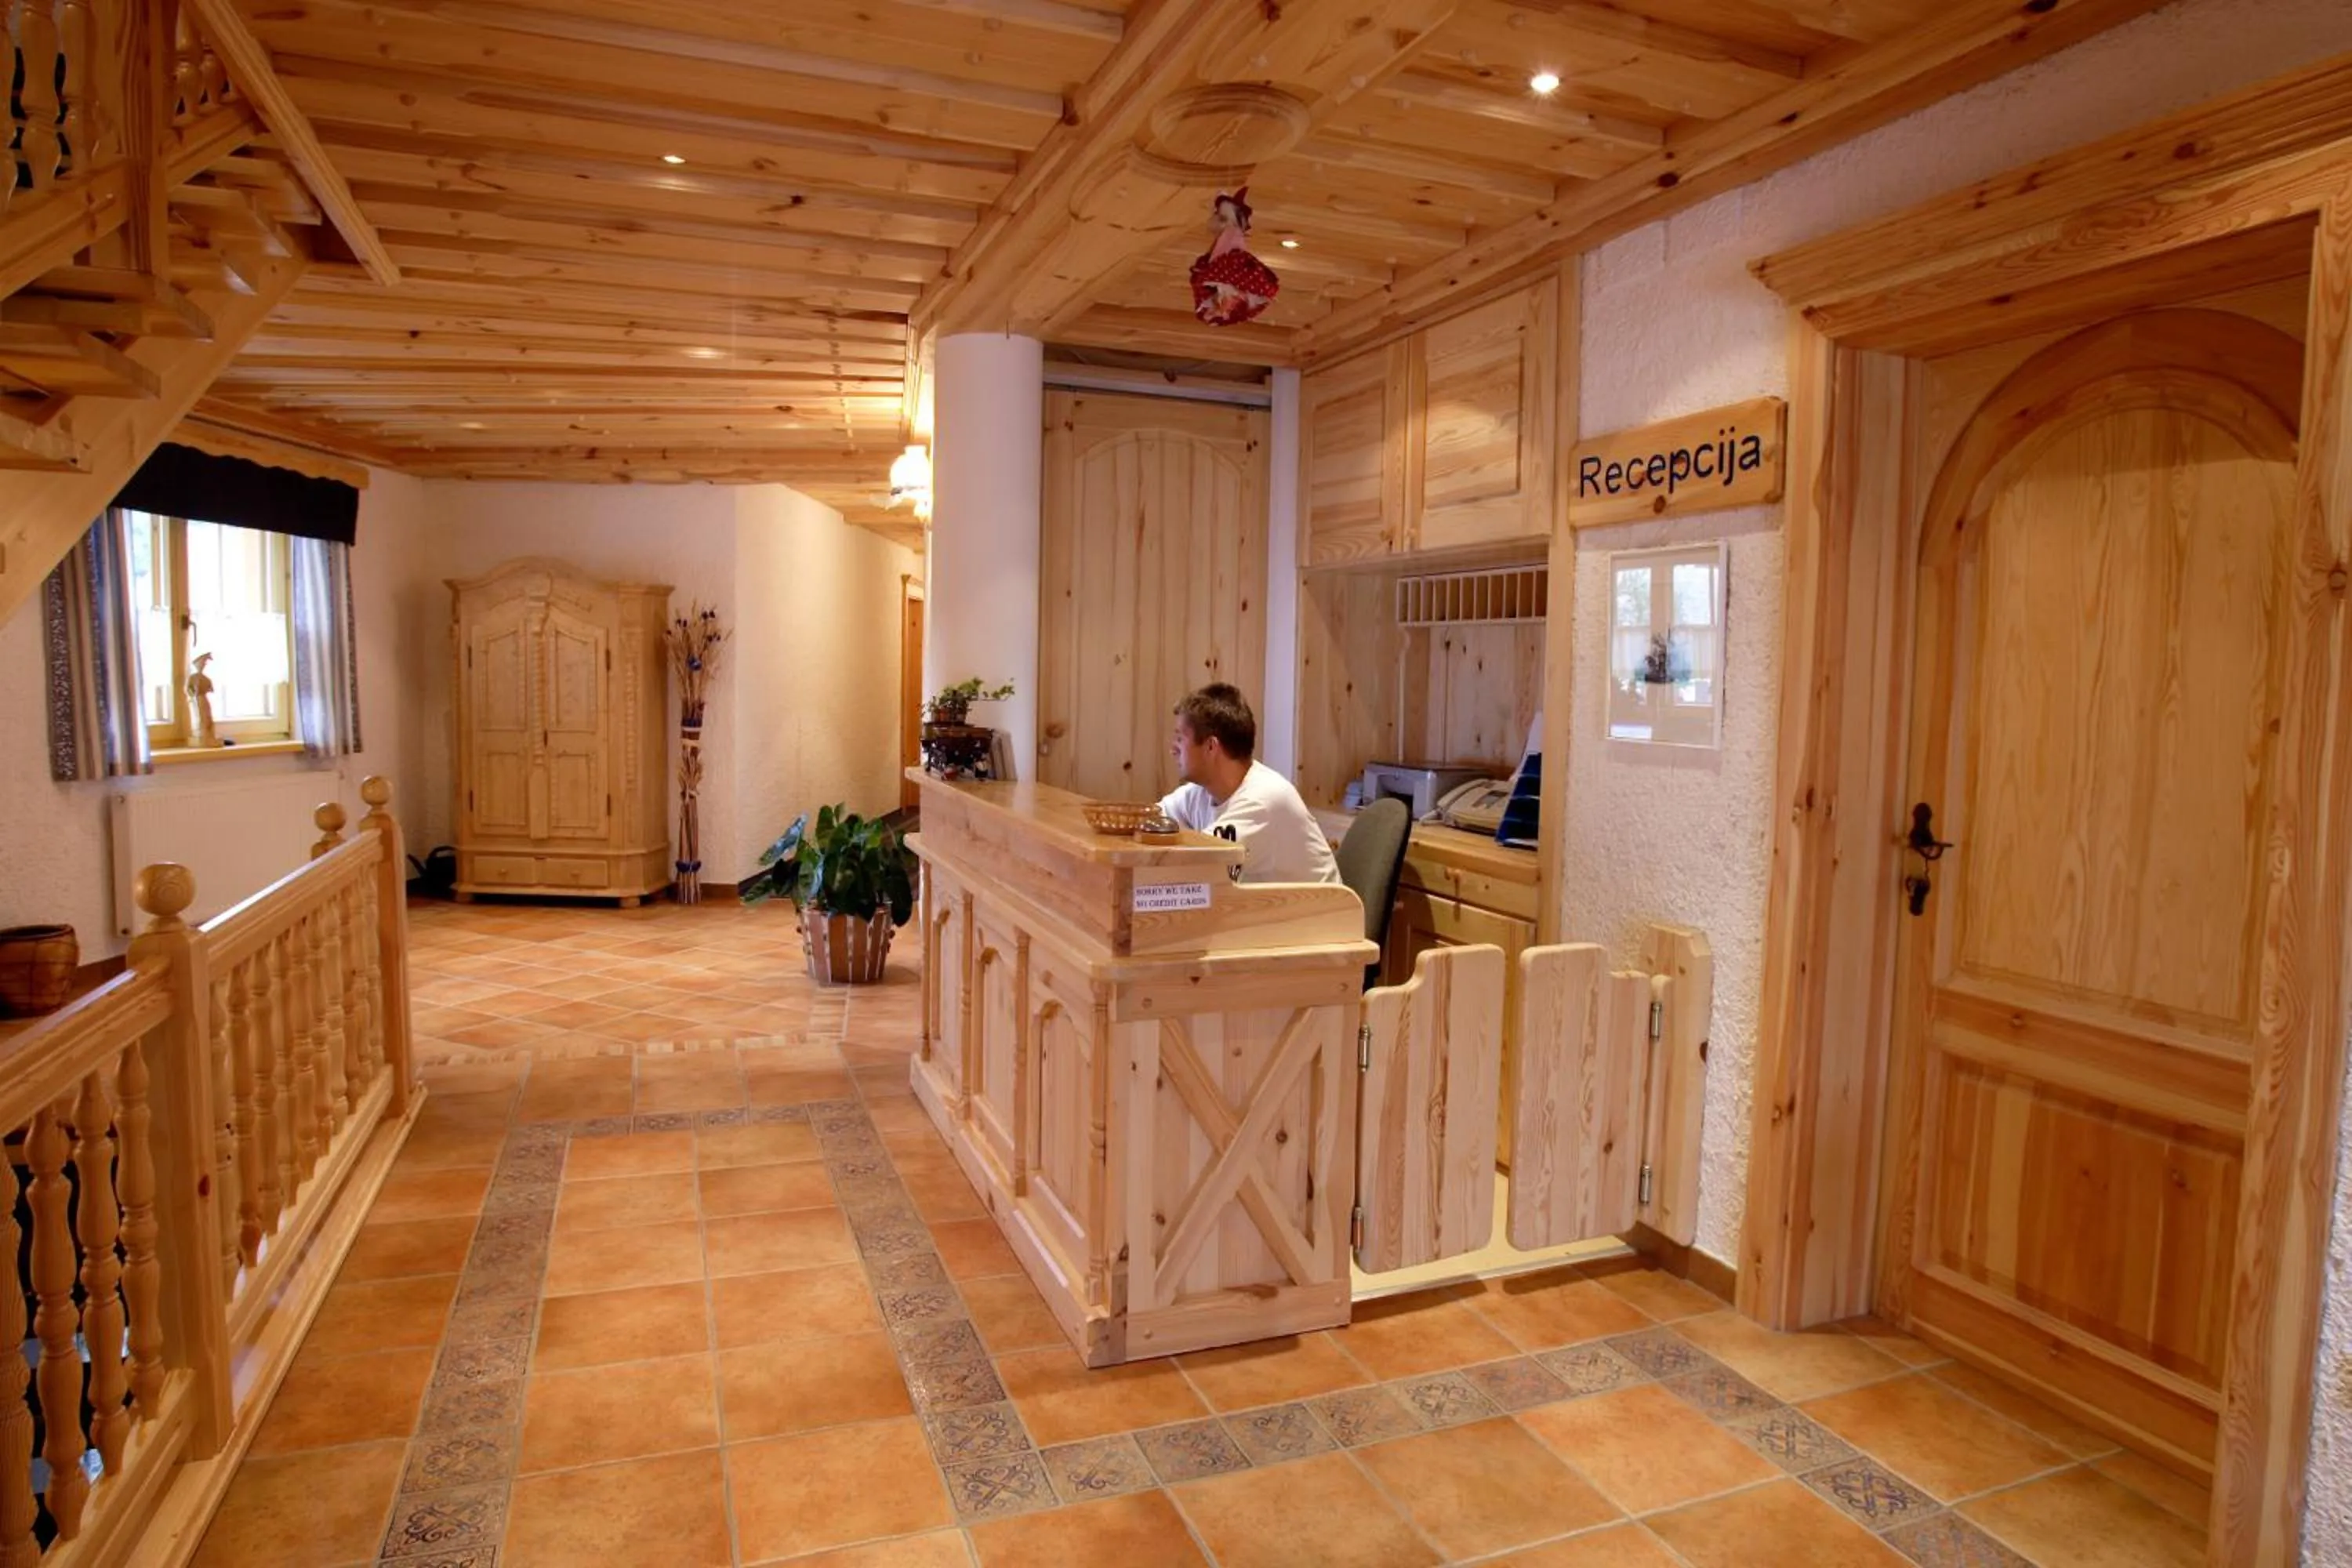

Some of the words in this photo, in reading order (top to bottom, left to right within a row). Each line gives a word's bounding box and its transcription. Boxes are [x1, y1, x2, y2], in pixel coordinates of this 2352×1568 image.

[1579, 426, 1762, 499] Recepcija
[1180, 885, 1203, 895] TAKE
[1149, 898, 1178, 907] CREDIT
[1180, 897, 1207, 906] CARDS
